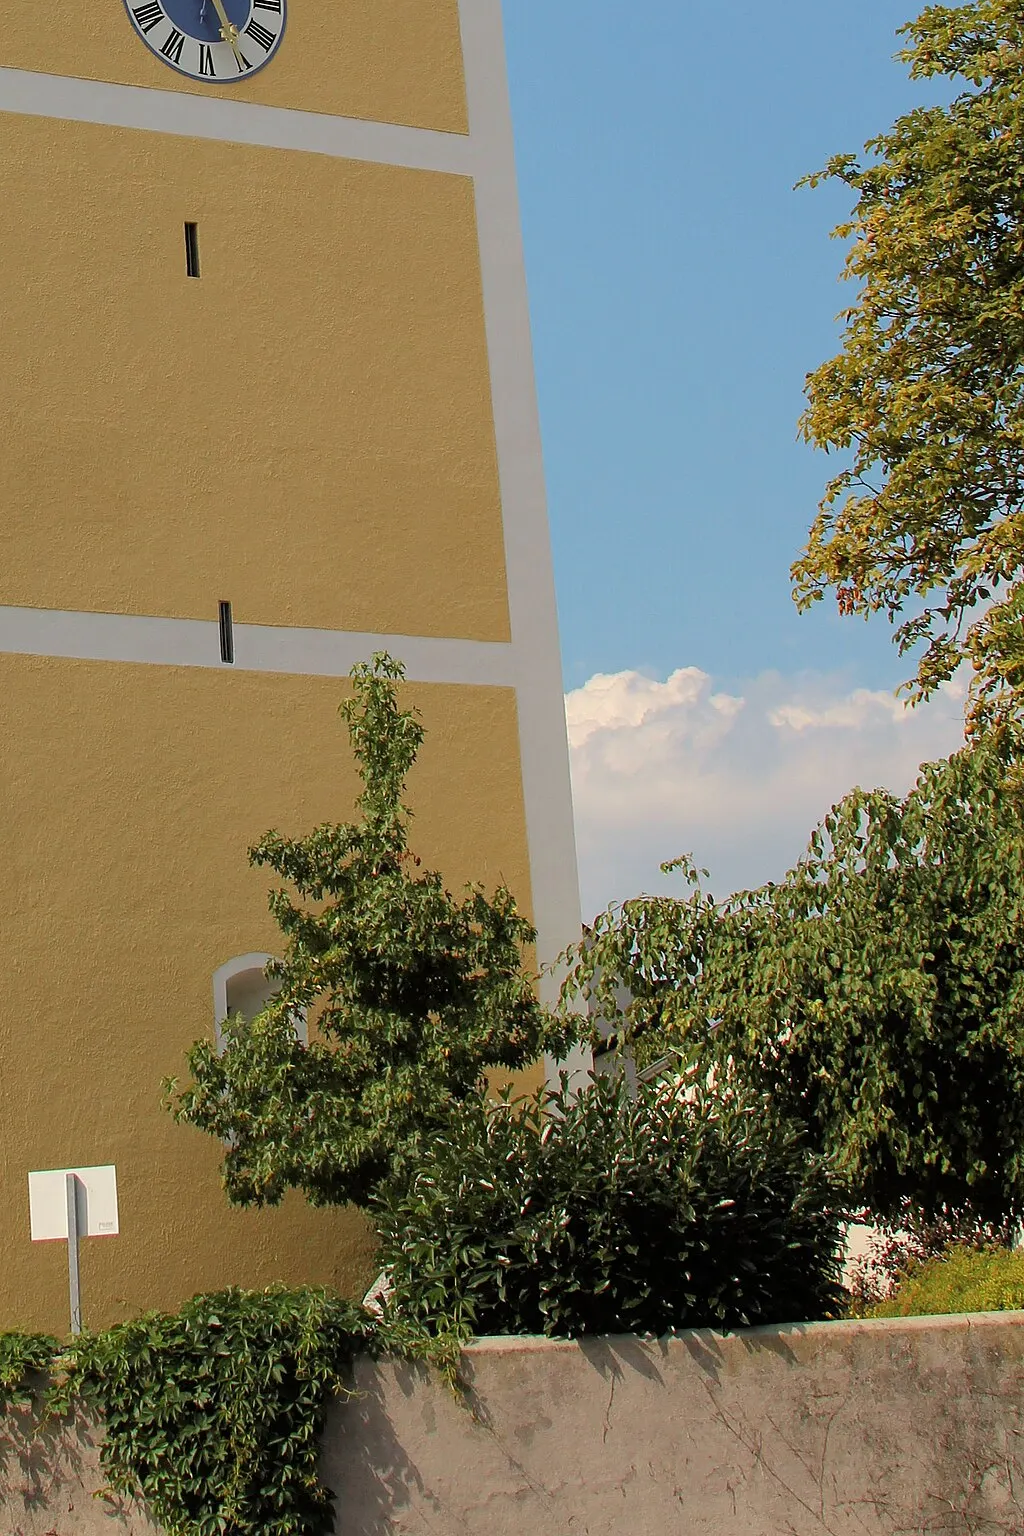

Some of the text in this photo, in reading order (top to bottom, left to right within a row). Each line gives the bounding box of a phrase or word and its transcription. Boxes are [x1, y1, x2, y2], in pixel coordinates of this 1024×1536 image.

[132, 0, 165, 35] VIII
[159, 27, 186, 65] VII
[245, 18, 276, 53] IIII
[199, 44, 216, 76] VI
[232, 47, 253, 73] V
